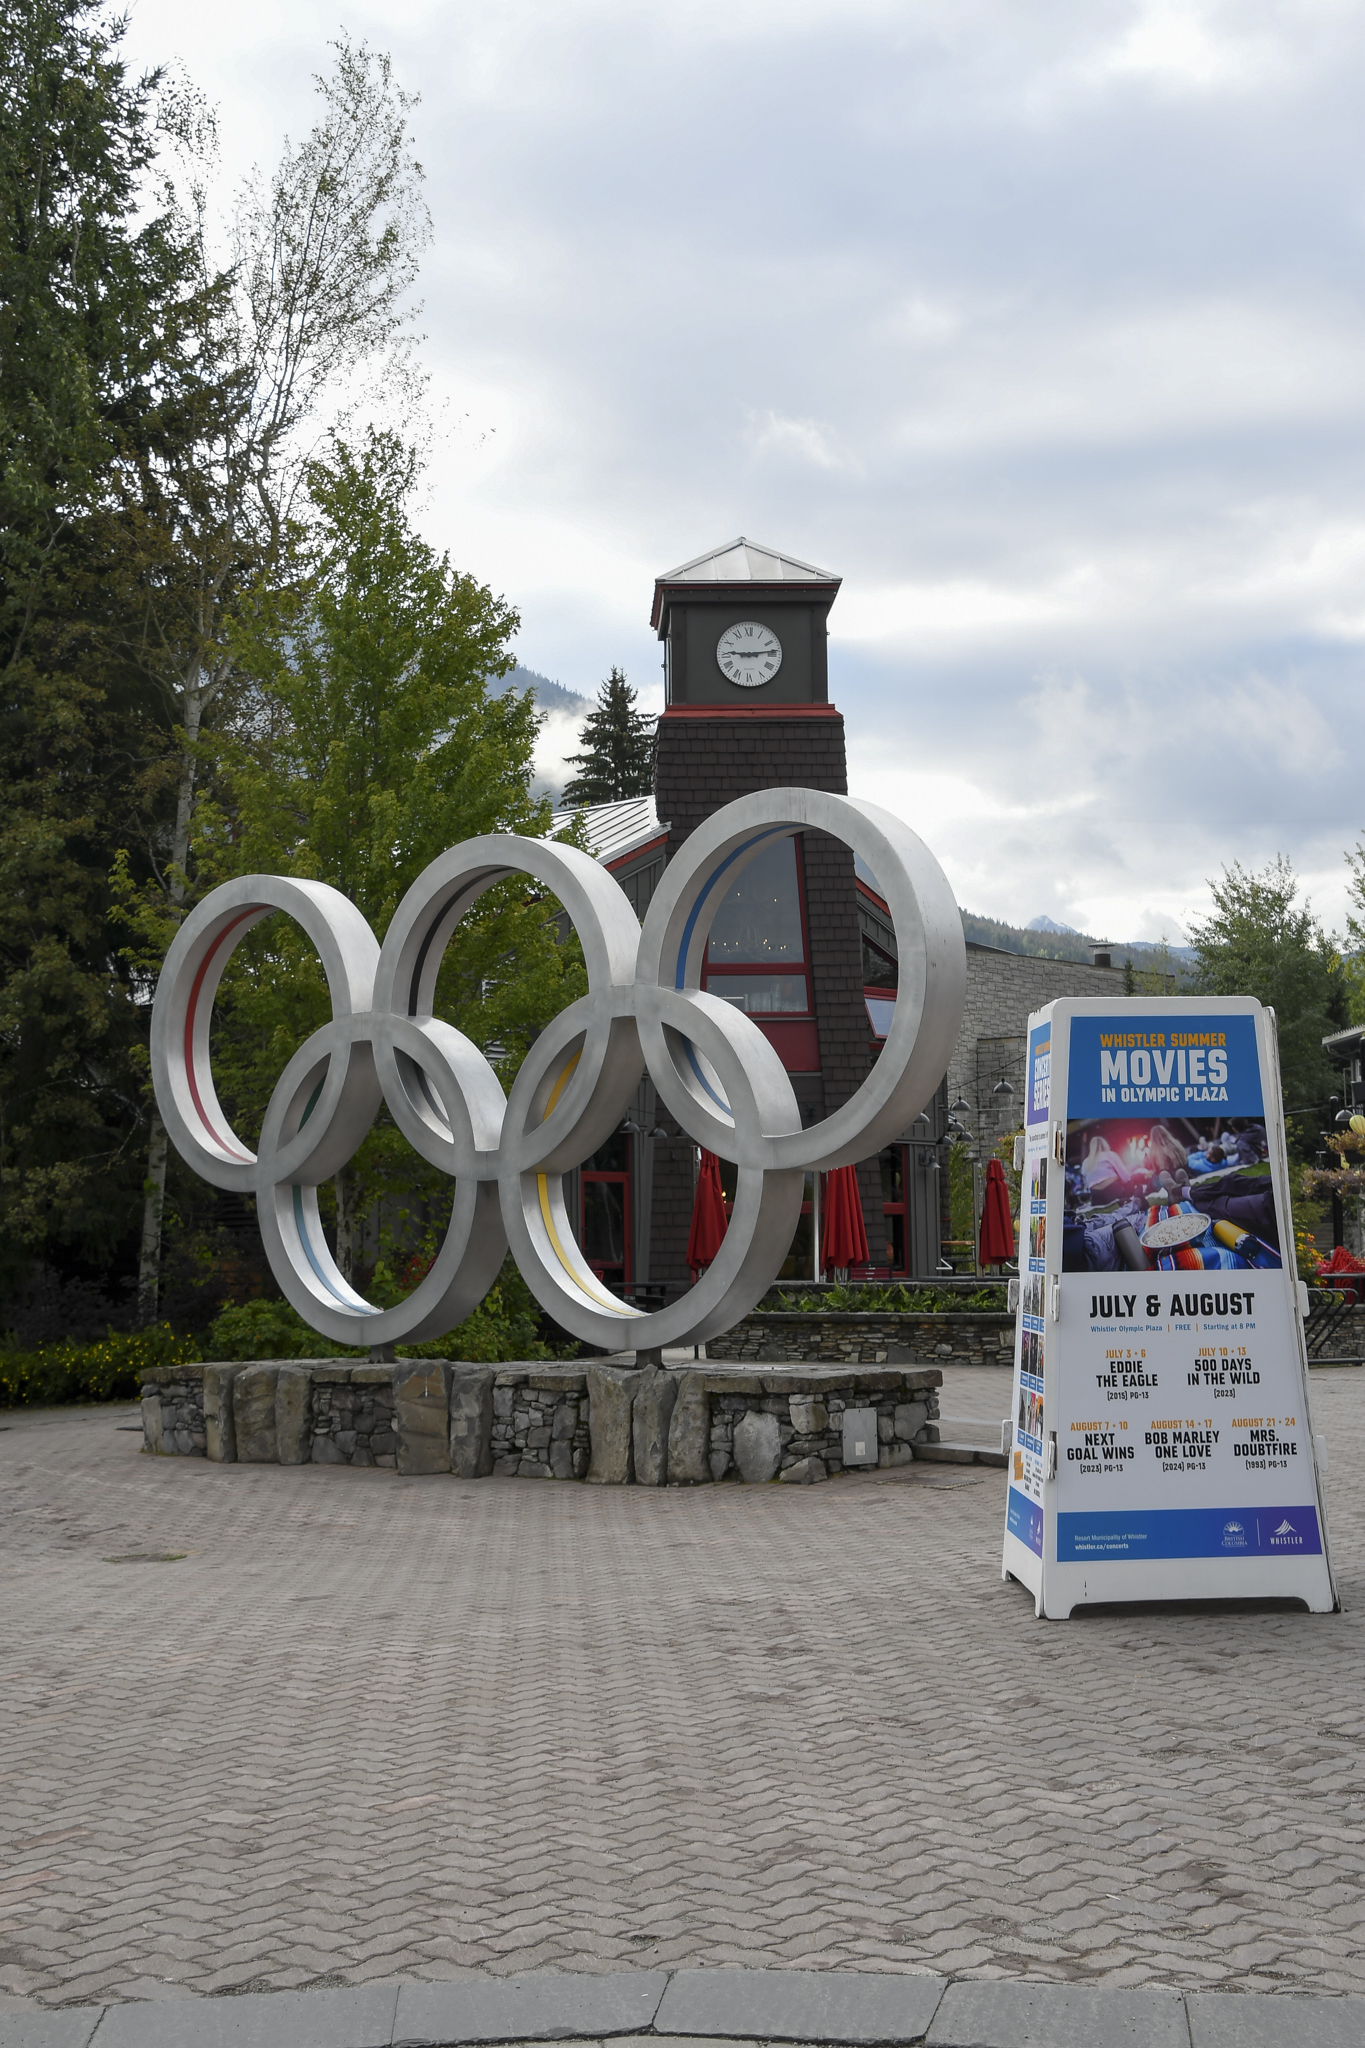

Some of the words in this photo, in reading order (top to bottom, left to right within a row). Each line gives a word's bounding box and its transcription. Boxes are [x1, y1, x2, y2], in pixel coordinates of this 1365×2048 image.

[1100, 1033, 1166, 1047] WHISTLER
[1170, 1032, 1227, 1047] SUMMER
[1100, 1048, 1228, 1085] MOVIES
[1101, 1088, 1116, 1102] IN
[1121, 1087, 1179, 1102] OLYMPIC
[1184, 1086, 1229, 1102] PLAZA
[1090, 1294, 1137, 1318] JULY
[1146, 1294, 1161, 1317] &
[1170, 1292, 1255, 1317] AUGUST
[1119, 1324, 1143, 1333] Olympic
[1203, 1323, 1229, 1331] Starting
[1105, 1349, 1123, 1359] JULY
[1126, 1349, 1131, 1358] 3
[1141, 1348, 1146, 1358] 6
[1198, 1347, 1216, 1357] JULY
[1219, 1347, 1228, 1356] 10
[1237, 1346, 1247, 1356] 13
[1110, 1360, 1143, 1374] EDDIE
[1194, 1359, 1217, 1371] 500
[1222, 1358, 1252, 1371] DAYS
[1096, 1374, 1118, 1388] THE
[1122, 1374, 1158, 1387] EAGLE
[1187, 1373, 1200, 1385] IN
[1203, 1372, 1226, 1385] THE
[1229, 1371, 1261, 1385] WILD
[1130, 1391, 1149, 1399] PG-13
[1070, 1421, 1102, 1431] AUGUST
[1105, 1421, 1110, 1430] 7
[1119, 1421, 1128, 1430] 10
[1151, 1419, 1182, 1429] AUGUST
[1185, 1419, 1195, 1429] 14
[1204, 1418, 1213, 1428] 17
[1231, 1417, 1263, 1427] AUGUST
[1266, 1417, 1276, 1427] 21
[1285, 1417, 1296, 1426] 24
[1084, 1432, 1115, 1446] NEXT
[1144, 1431, 1168, 1445] BOB
[1172, 1430, 1220, 1444] MARLEY
[1250, 1429, 1280, 1442] MRS.
[1067, 1447, 1098, 1460] GOAL
[1101, 1446, 1135, 1460] WINS
[1155, 1445, 1178, 1458] ONE
[1182, 1444, 1212, 1458] LOVE
[1233, 1442, 1298, 1457] DOUBTFIRE
[1103, 1464, 1124, 1472] PG-13
[1186, 1462, 1206, 1470] PG-13
[1268, 1460, 1288, 1468] PG-13
[1074, 1542, 1130, 1551] whistler.ca/concerts
[1270, 1536, 1304, 1545] WHISTLER
